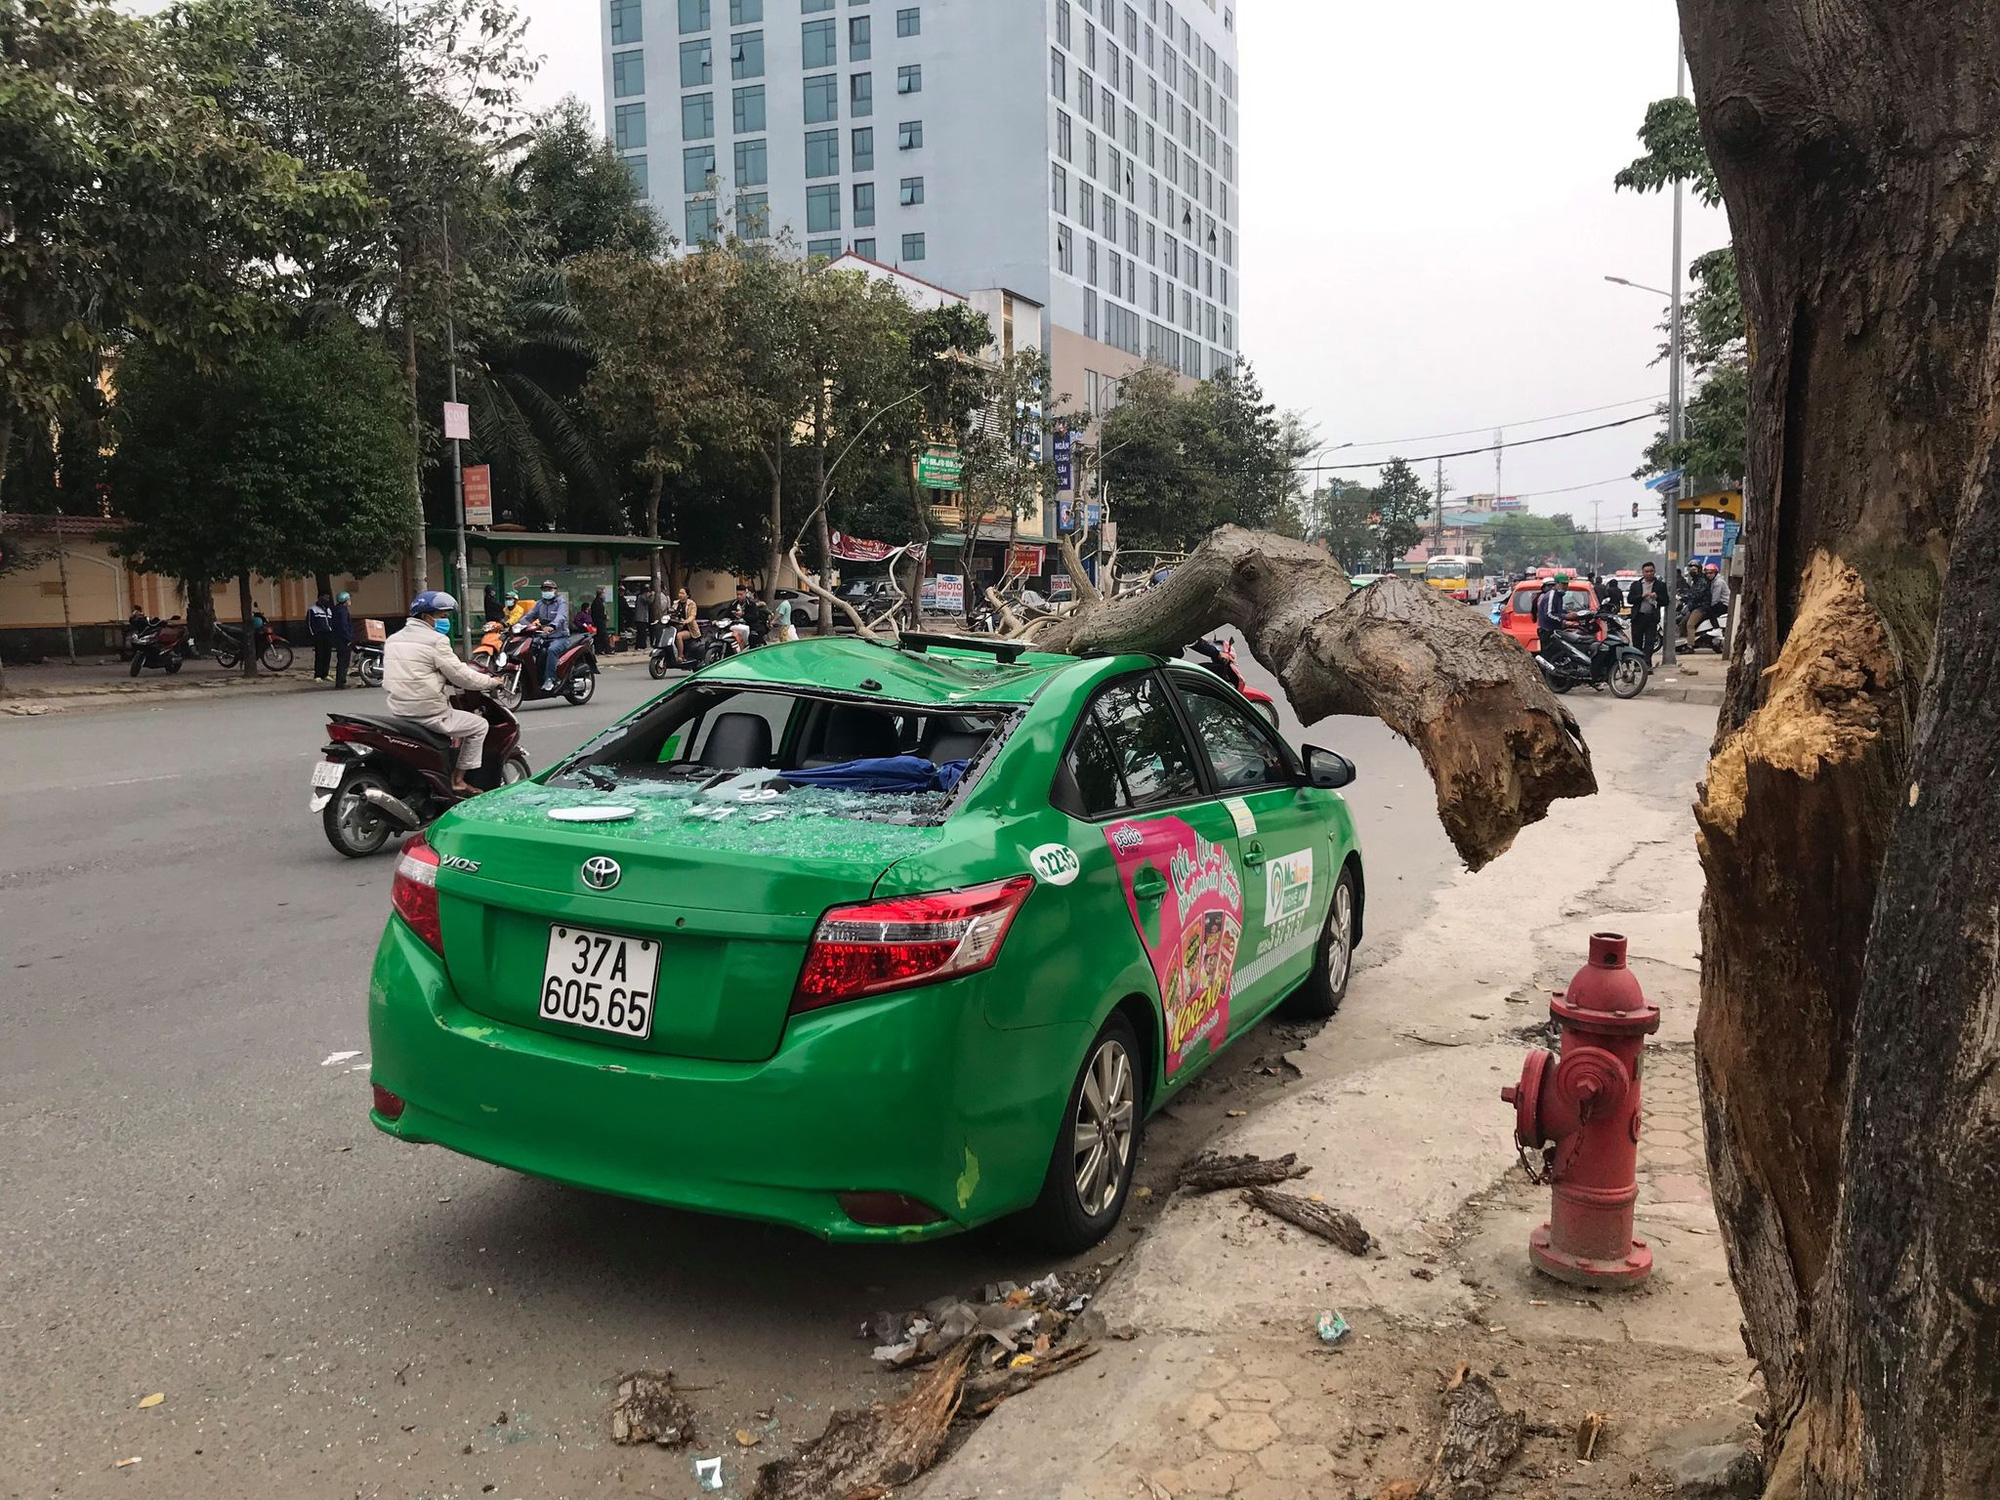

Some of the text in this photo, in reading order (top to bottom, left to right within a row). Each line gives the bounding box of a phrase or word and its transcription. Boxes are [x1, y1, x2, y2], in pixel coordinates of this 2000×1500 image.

[937, 581, 963, 591] PHOTO
[443, 854, 482, 872] VIOS
[572, 934, 627, 983] 37A
[543, 975, 649, 1032] 605.65
